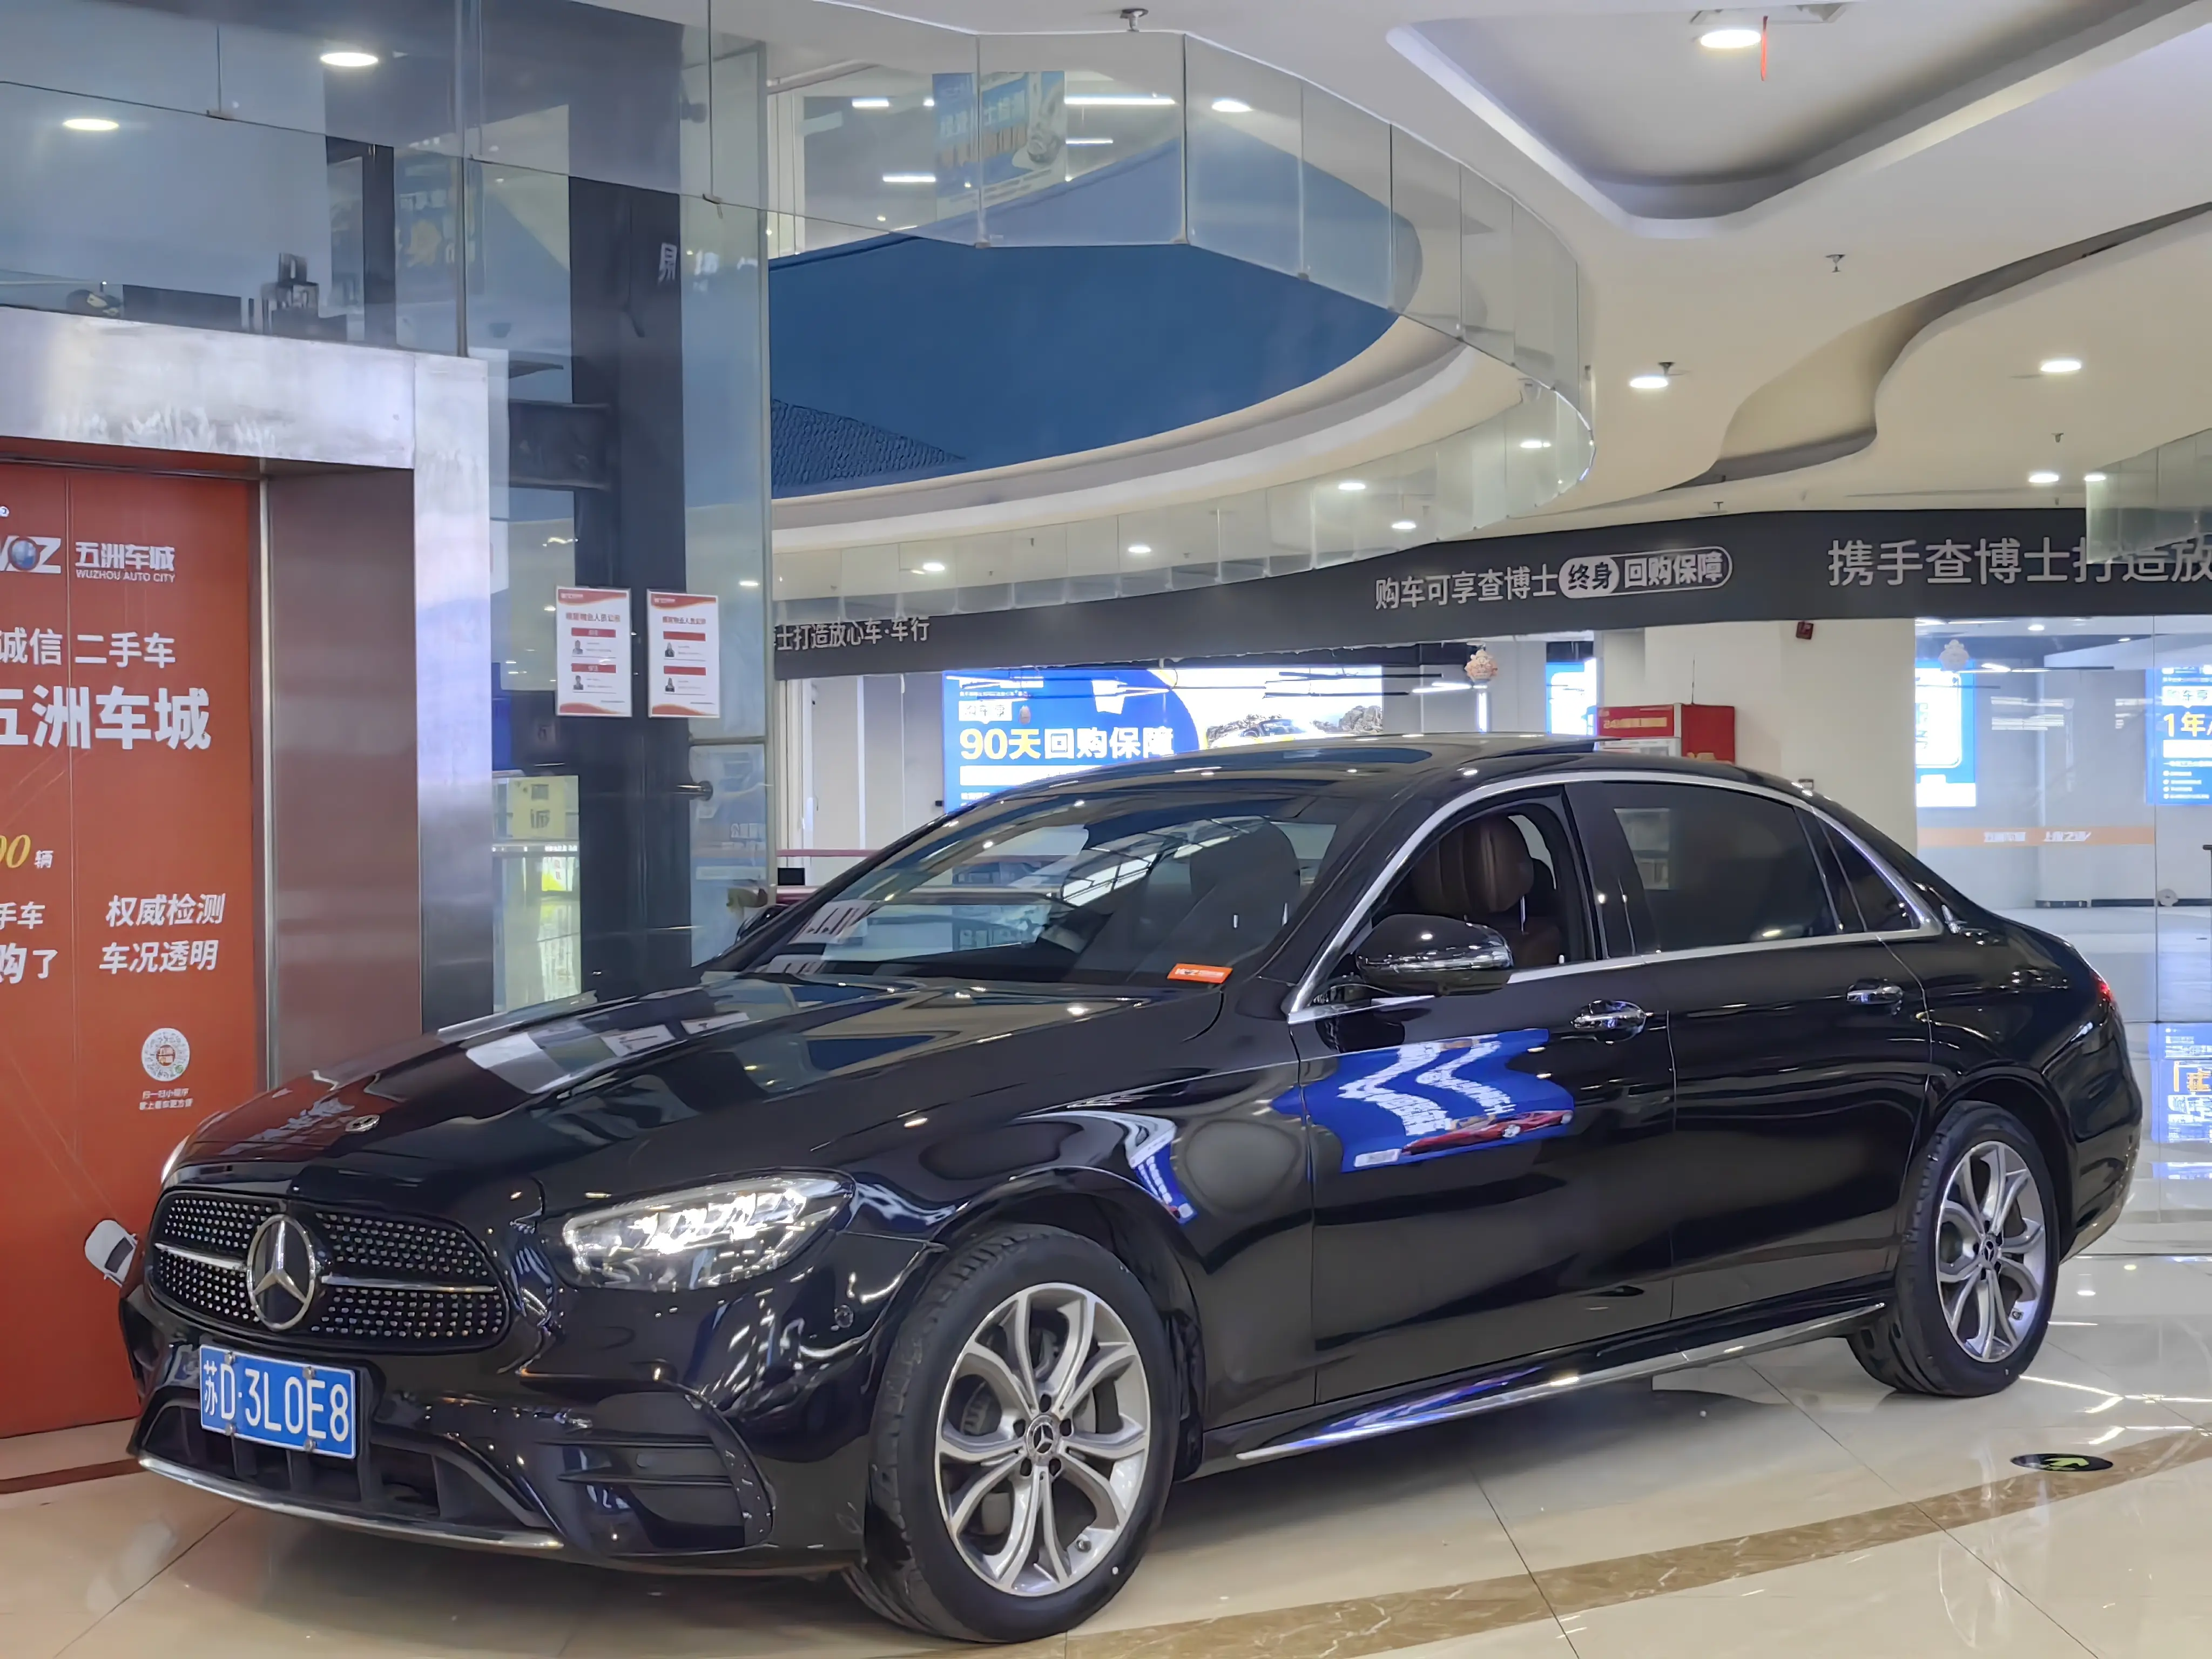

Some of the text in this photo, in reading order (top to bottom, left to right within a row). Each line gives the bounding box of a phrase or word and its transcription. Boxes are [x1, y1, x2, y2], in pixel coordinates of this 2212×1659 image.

[75, 542, 175, 571] 五洲车城
[76, 569, 176, 583] WUZHOU AUTO CITY
[1375, 552, 1724, 610] 购车可享查博士 终身 回购保障
[75, 632, 176, 669] 二手车
[960, 726, 1175, 760] 90天回购保障
[105, 893, 226, 928] 权威检测
[99, 939, 219, 974] 车况透明
